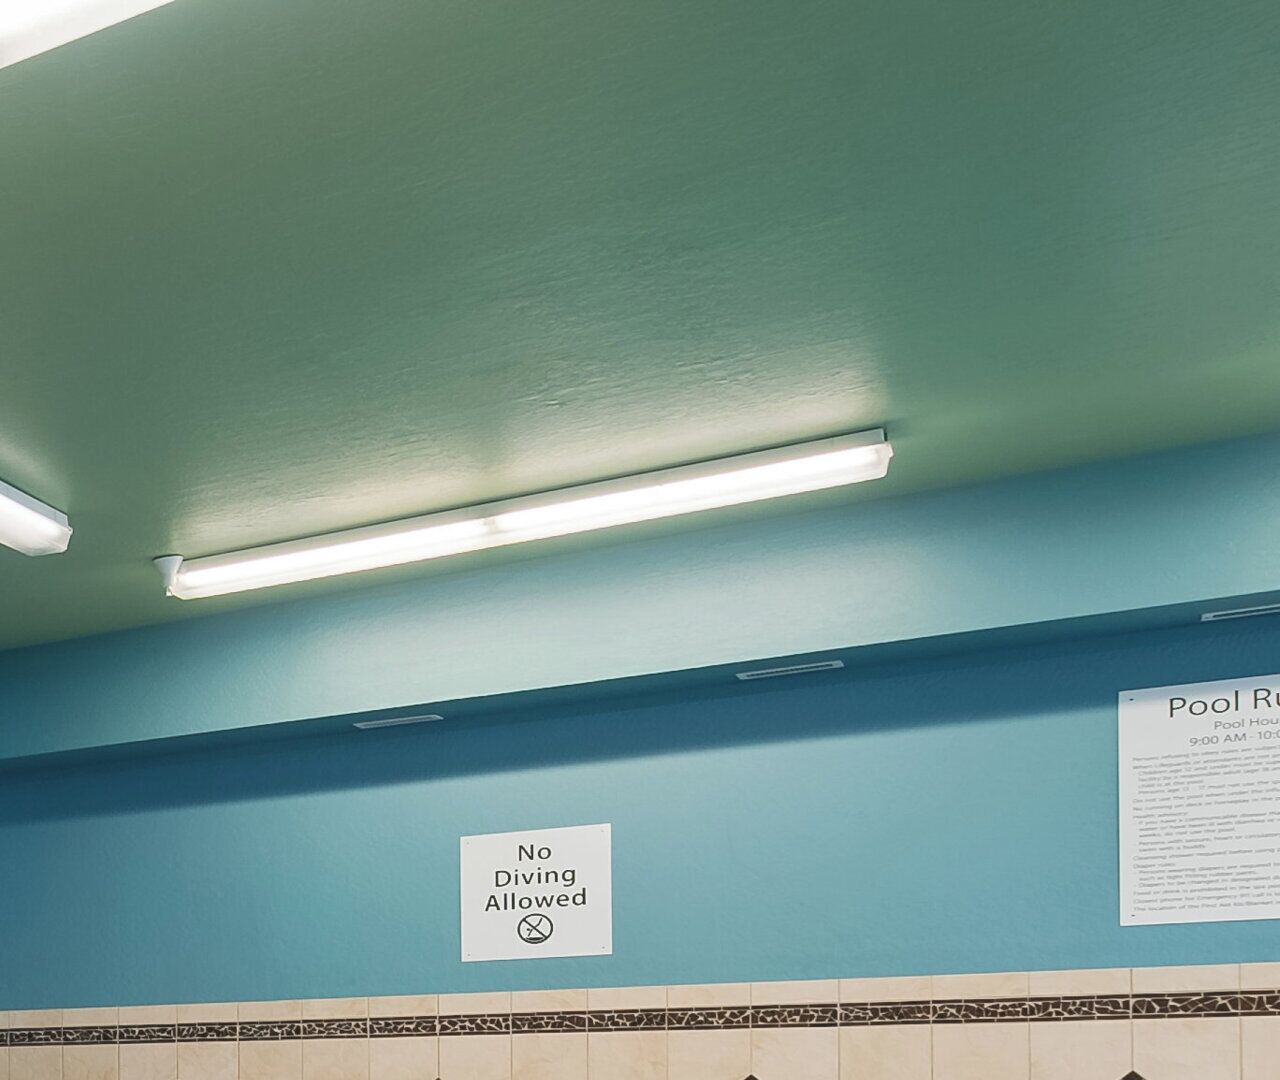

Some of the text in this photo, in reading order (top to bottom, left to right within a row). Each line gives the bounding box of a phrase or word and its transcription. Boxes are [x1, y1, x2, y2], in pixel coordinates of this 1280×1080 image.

[1169, 690, 1239, 718] Pool
[1213, 719, 1245, 730] Pool
[1189, 735, 1219, 747] 9:00
[1223, 732, 1247, 743] AM
[518, 844, 552, 861] No
[495, 867, 576, 887] Diving
[485, 887, 587, 912] Allowed
